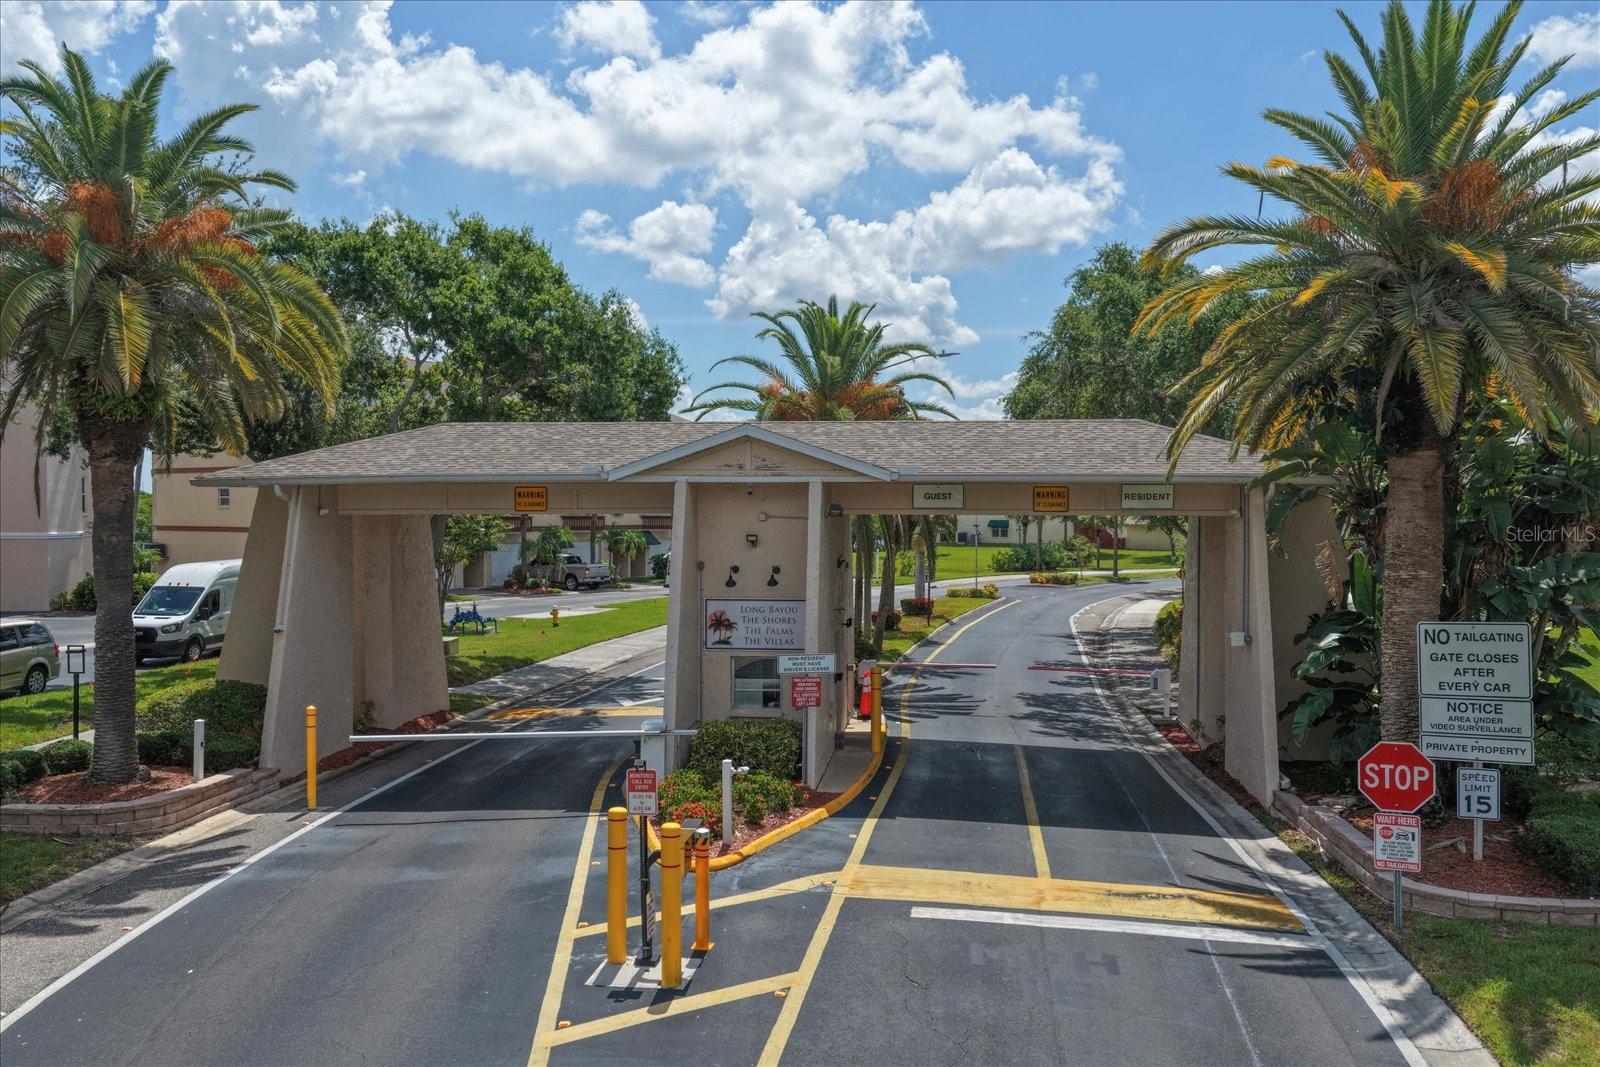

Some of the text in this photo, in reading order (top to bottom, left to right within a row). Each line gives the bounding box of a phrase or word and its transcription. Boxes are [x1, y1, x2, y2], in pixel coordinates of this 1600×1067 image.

[517, 491, 545, 499] WARNING
[923, 492, 953, 500] GUEST
[1035, 490, 1067, 499] WARNING
[1124, 493, 1171, 501] RESIDENT
[741, 616, 797, 625] THE SHORES
[744, 626, 794, 635] THE PALMS
[743, 636, 795, 646] THE VILLAS
[1424, 628, 1524, 645] NO TAILGATING
[1429, 652, 1519, 664] GATE CLOSES
[1453, 667, 1495, 678] AFTER
[1438, 681, 1511, 693] EVERY CAR
[1446, 701, 1504, 715] NOTICE
[1447, 715, 1503, 725] AREA UNDER
[1429, 722, 1523, 735] VIDEO SURVEILLANCE
[1425, 742, 1527, 756] PRIVATE PROPERTY
[1363, 762, 1430, 792] STOP
[1461, 773, 1496, 783] SPEED
[1464, 784, 1492, 793] LIMIT
[1464, 794, 1492, 814] 15
[1376, 815, 1418, 827] WAIT HERE
[1386, 862, 1419, 871] TAILGATING
